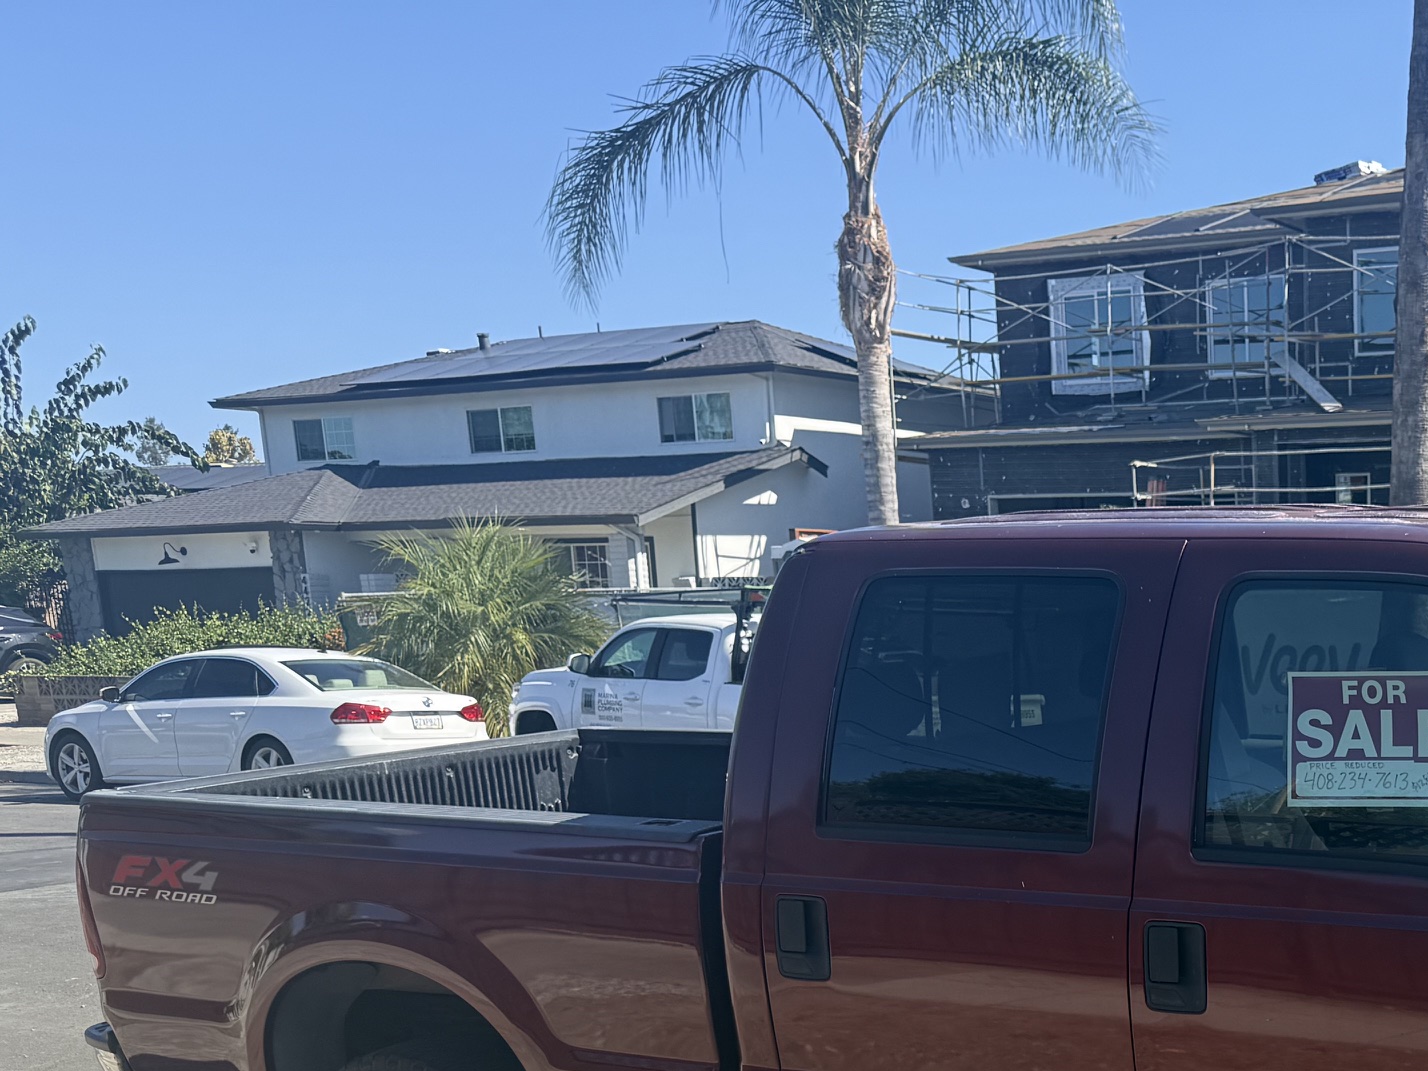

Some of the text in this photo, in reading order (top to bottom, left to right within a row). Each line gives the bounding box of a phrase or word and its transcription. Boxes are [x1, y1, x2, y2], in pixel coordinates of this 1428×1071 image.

[1341, 679, 1407, 705] FOR
[1309, 761, 1385, 771] PRICE REDUCED
[112, 855, 219, 891] FX4
[109, 885, 218, 905] OFF ROAD
